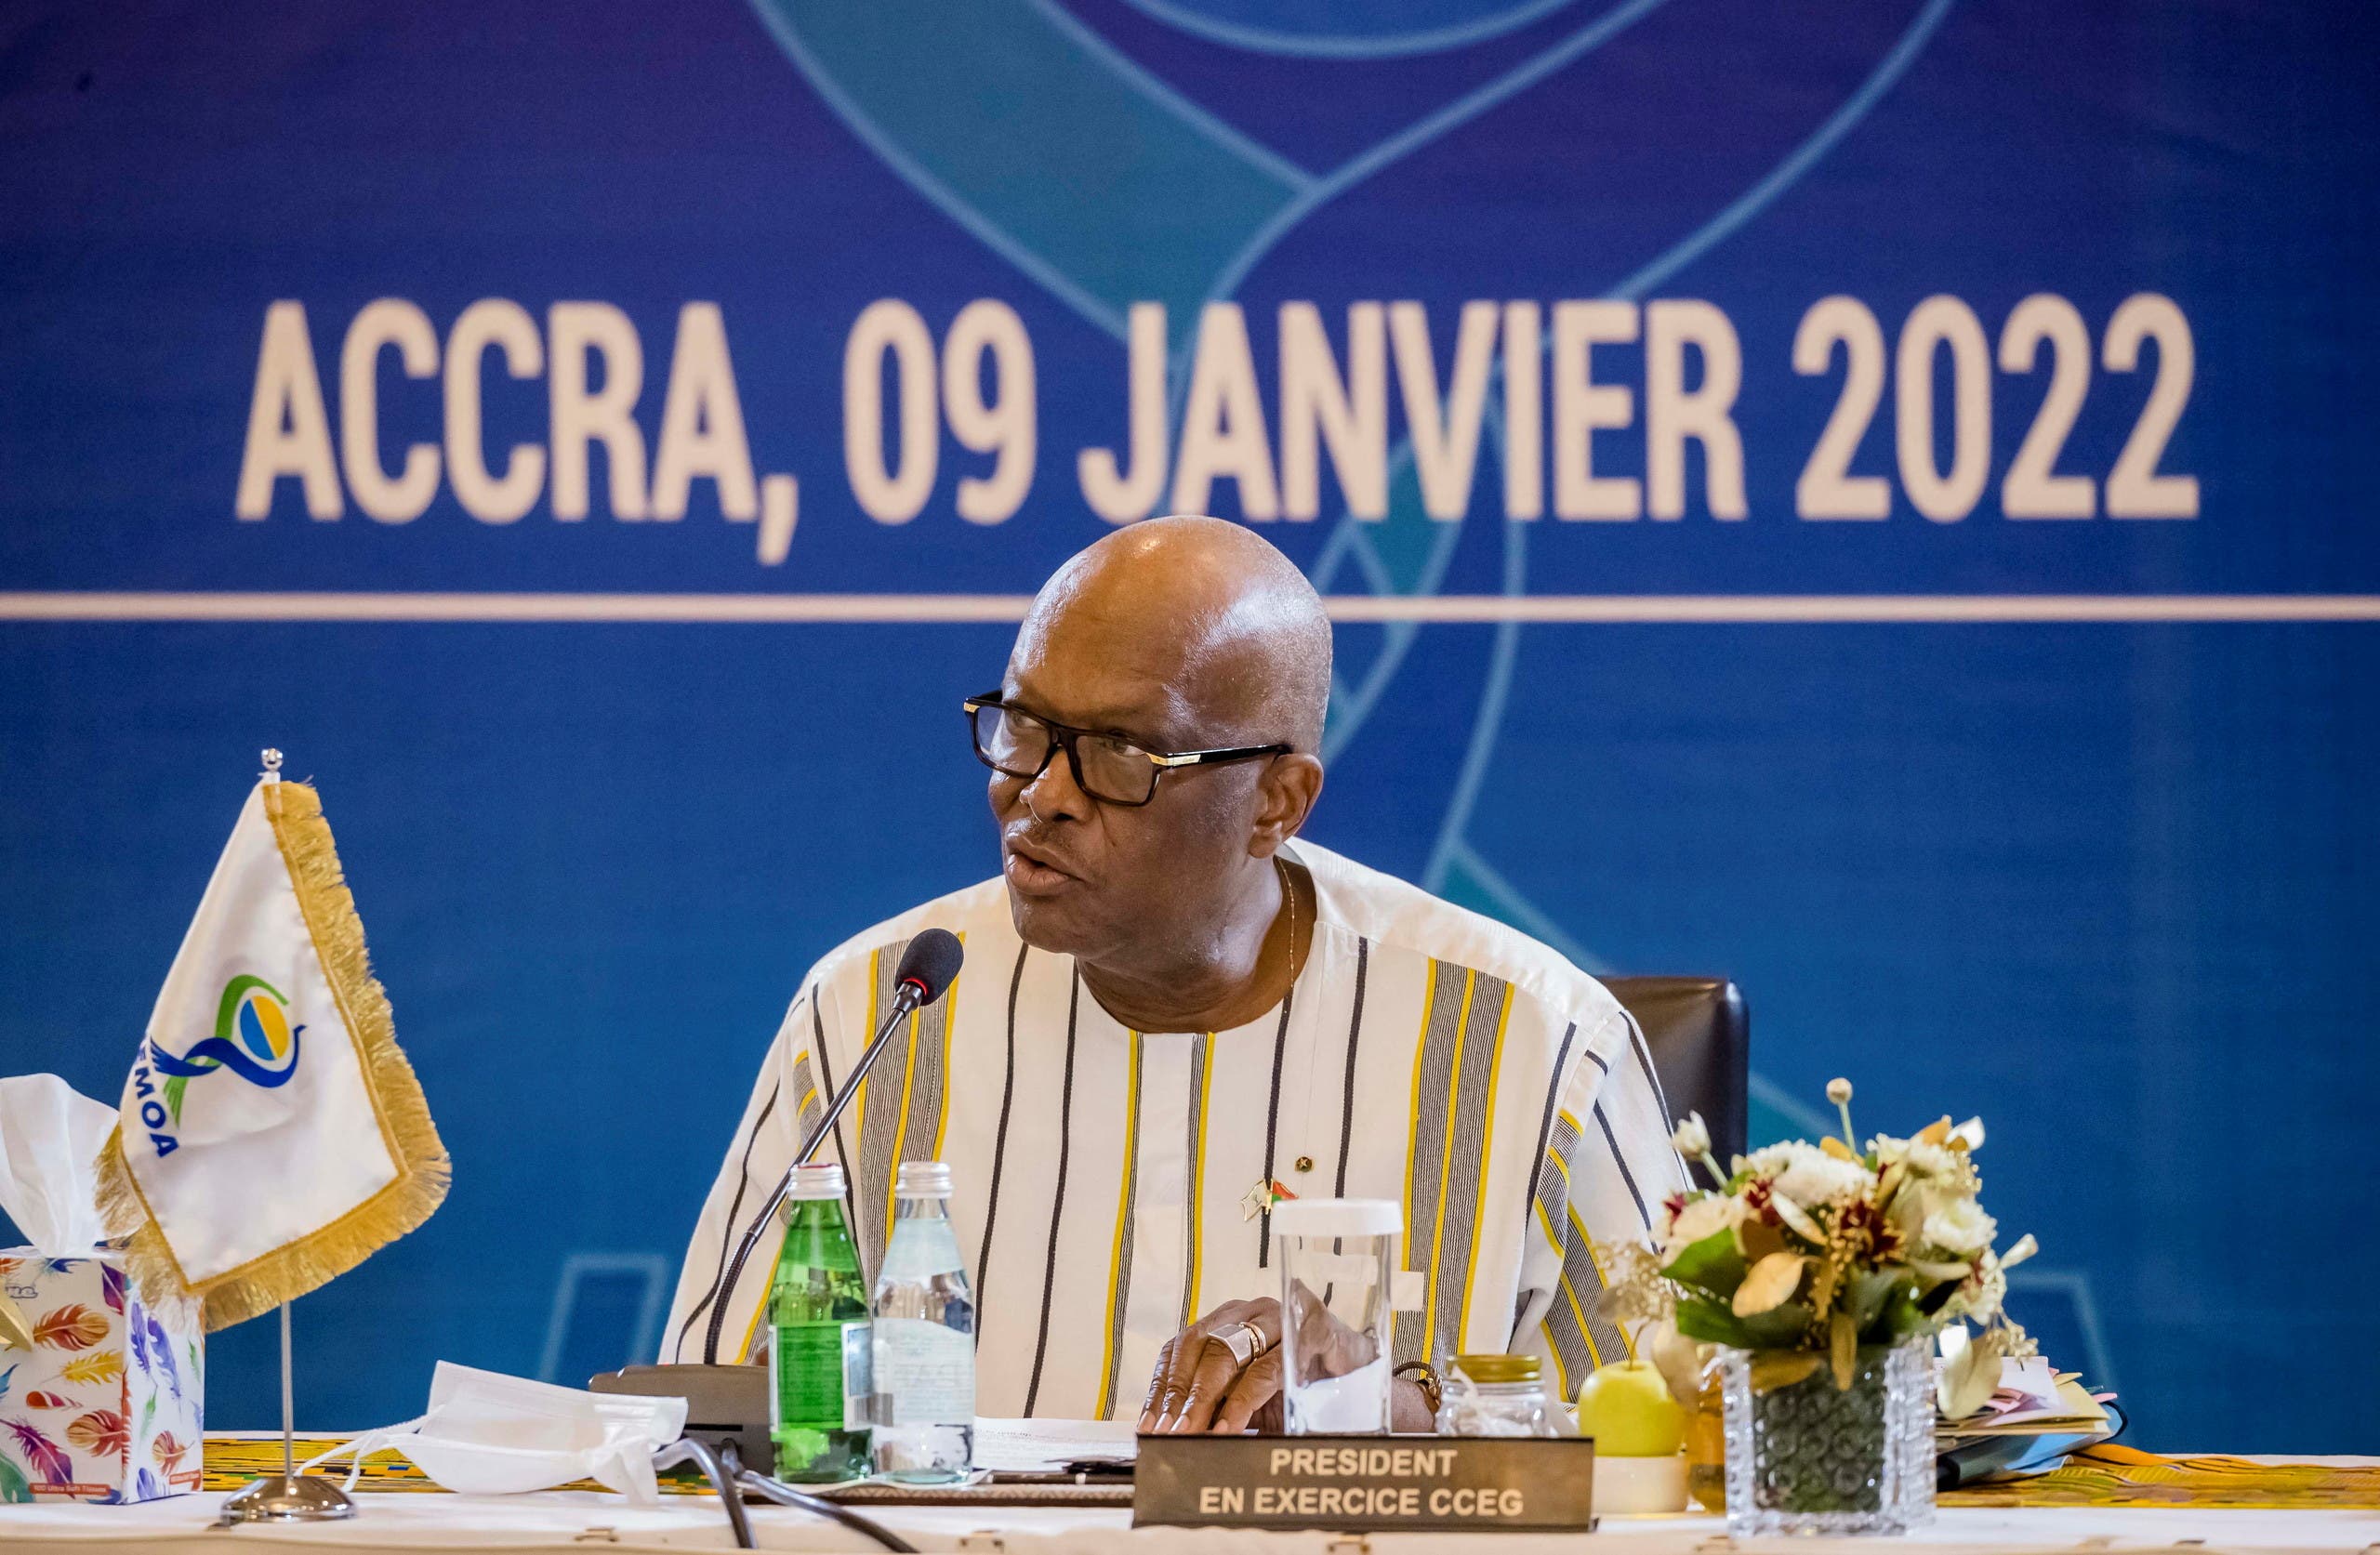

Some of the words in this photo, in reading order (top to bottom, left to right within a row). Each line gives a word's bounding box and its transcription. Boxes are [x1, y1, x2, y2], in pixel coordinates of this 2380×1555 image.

[236, 298, 798, 564] ACCRA,
[843, 298, 1038, 524] 09
[1077, 299, 1749, 524] JANVIER
[1792, 294, 2201, 524] 2022
[1270, 1448, 1458, 1476] PRESIDENT
[1199, 1487, 1244, 1514] EN
[1253, 1487, 1420, 1515] EXERCICE
[1429, 1488, 1524, 1517] CCEG
